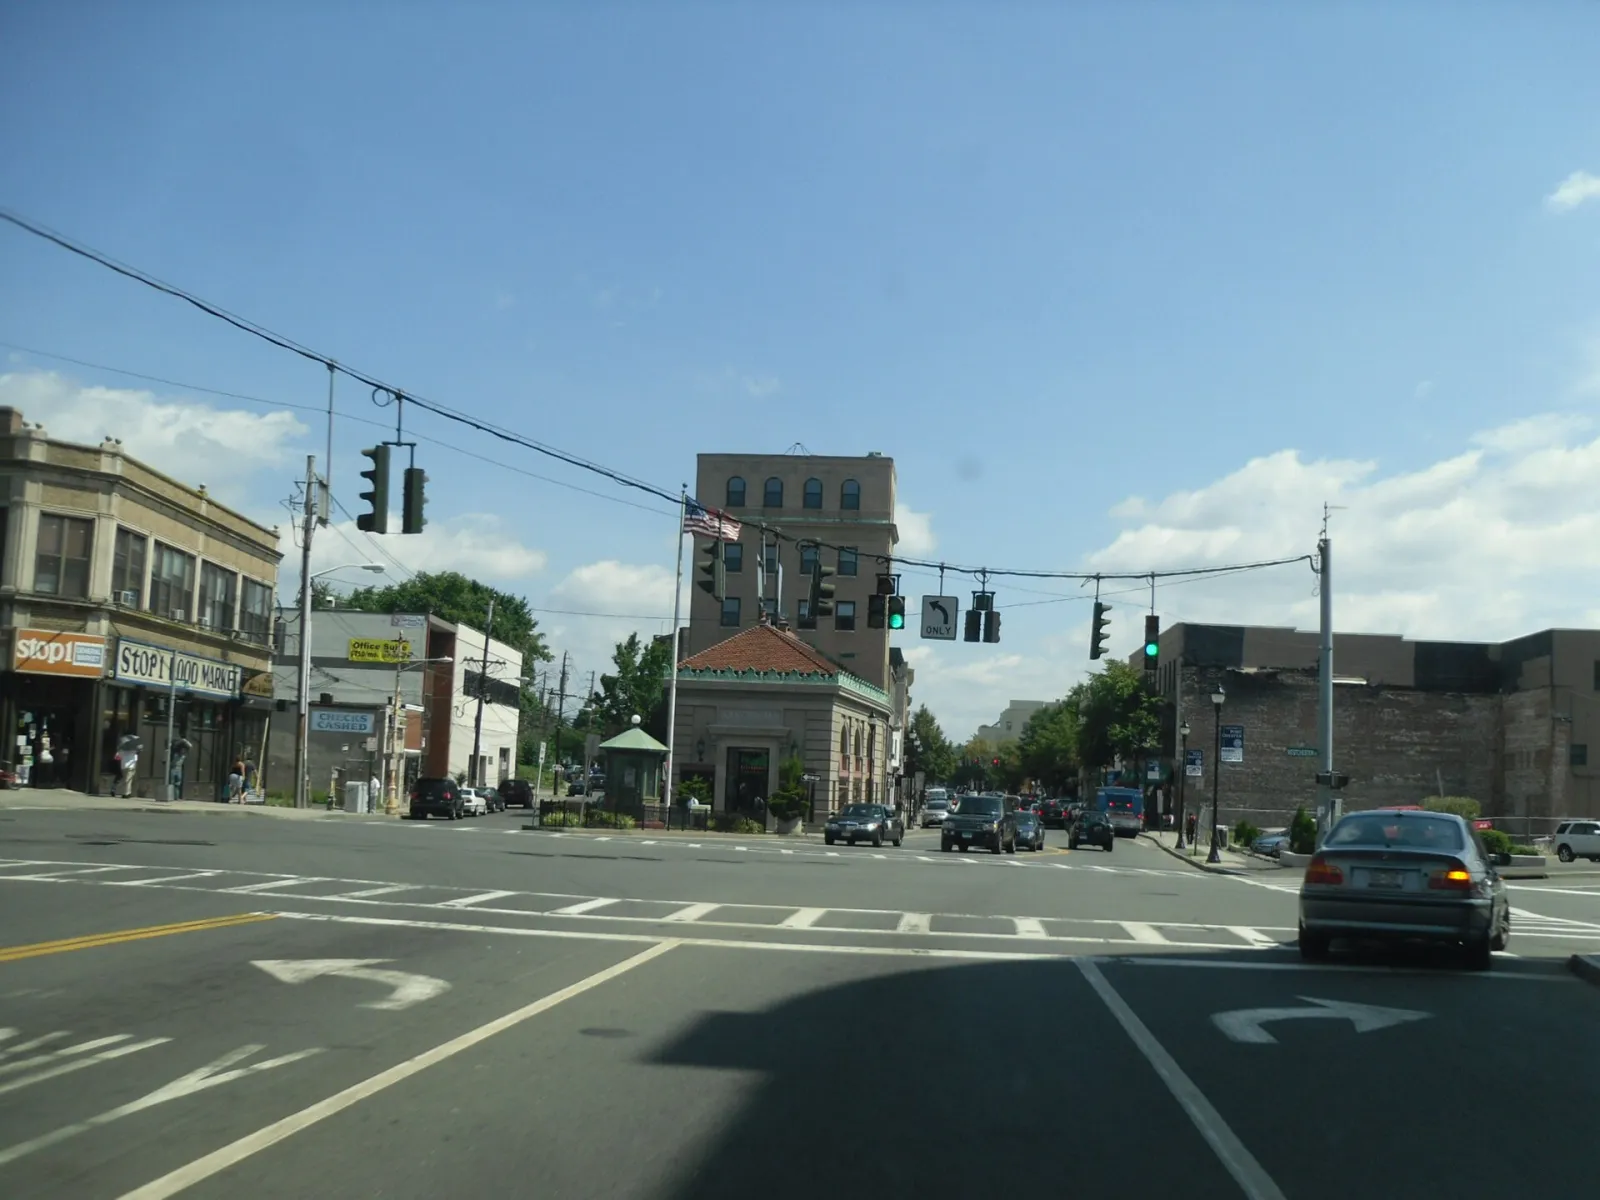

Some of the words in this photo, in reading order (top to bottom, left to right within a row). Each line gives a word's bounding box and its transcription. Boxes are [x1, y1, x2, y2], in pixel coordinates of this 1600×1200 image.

[925, 626, 951, 635] ONLY
[353, 641, 380, 650] Office
[383, 643, 407, 651] Suie
[202, 664, 239, 691] MARKET
[319, 713, 368, 722] CHECKS
[317, 721, 368, 731] CASHED
